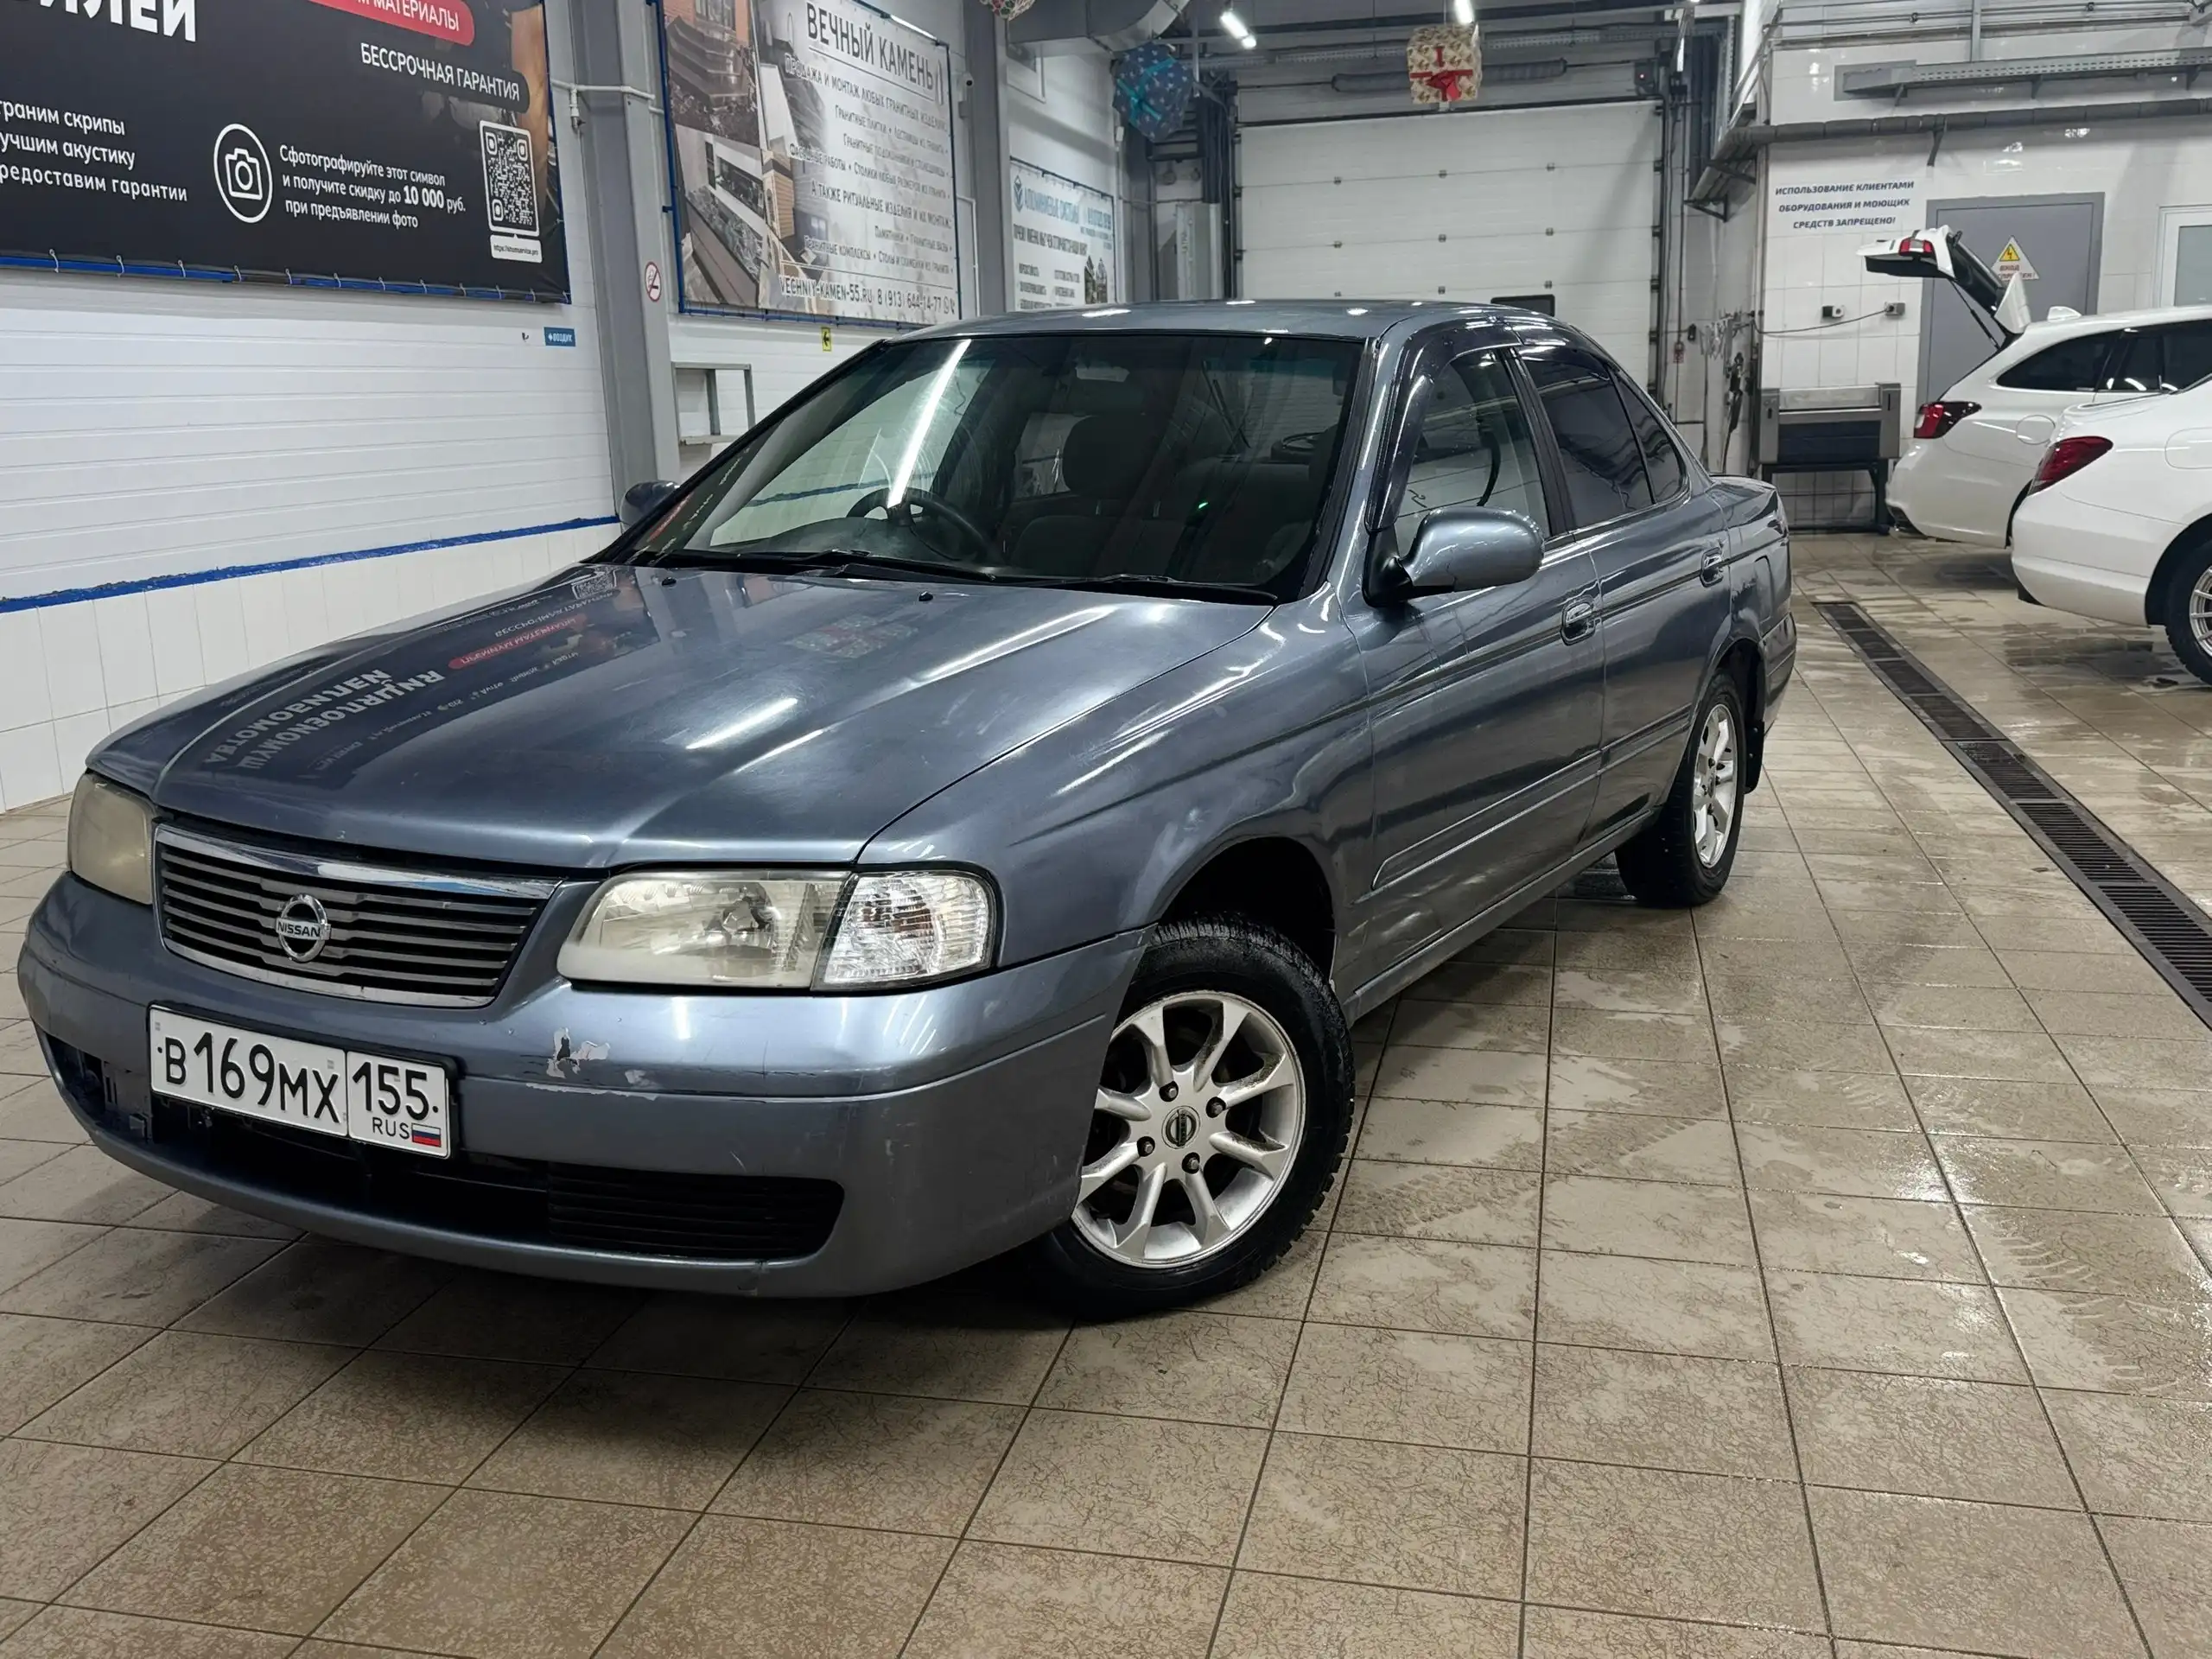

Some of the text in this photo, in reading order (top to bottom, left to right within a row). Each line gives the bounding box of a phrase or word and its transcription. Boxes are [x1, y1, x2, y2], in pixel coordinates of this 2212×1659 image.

[805, 3, 934, 90] ВЕЧНЫЙ КАМЕНЬ
[360, 42, 520, 101] БЕССРОЧНАЯ ГАРАНТИЯ
[824, 72, 830, 86] И
[832, 75, 860, 98] МОНТАЖ
[0, 100, 125, 136] раним скрипы
[62, 141, 136, 170] акустику
[279, 144, 445, 187] Сфотографируйте этот символ
[111, 178, 188, 202] гарантии
[283, 175, 466, 214] и получите скидку до 10 000 руб.
[1775, 181, 1915, 195] ИСПОЛЬЗОВАНИЕ КЛИЕНТАМИ
[285, 200, 418, 229] при предъявлении фото
[1778, 201, 1853, 213] ОБОРУДОВАНИЯ
[1863, 198, 1910, 209] МОЮЩИХ
[1793, 217, 1897, 230] СРЕДСТВ ЗАПРЕЩЕНО!
[277, 921, 321, 938] NISSAN
[372, 1116, 410, 1140] RUS
